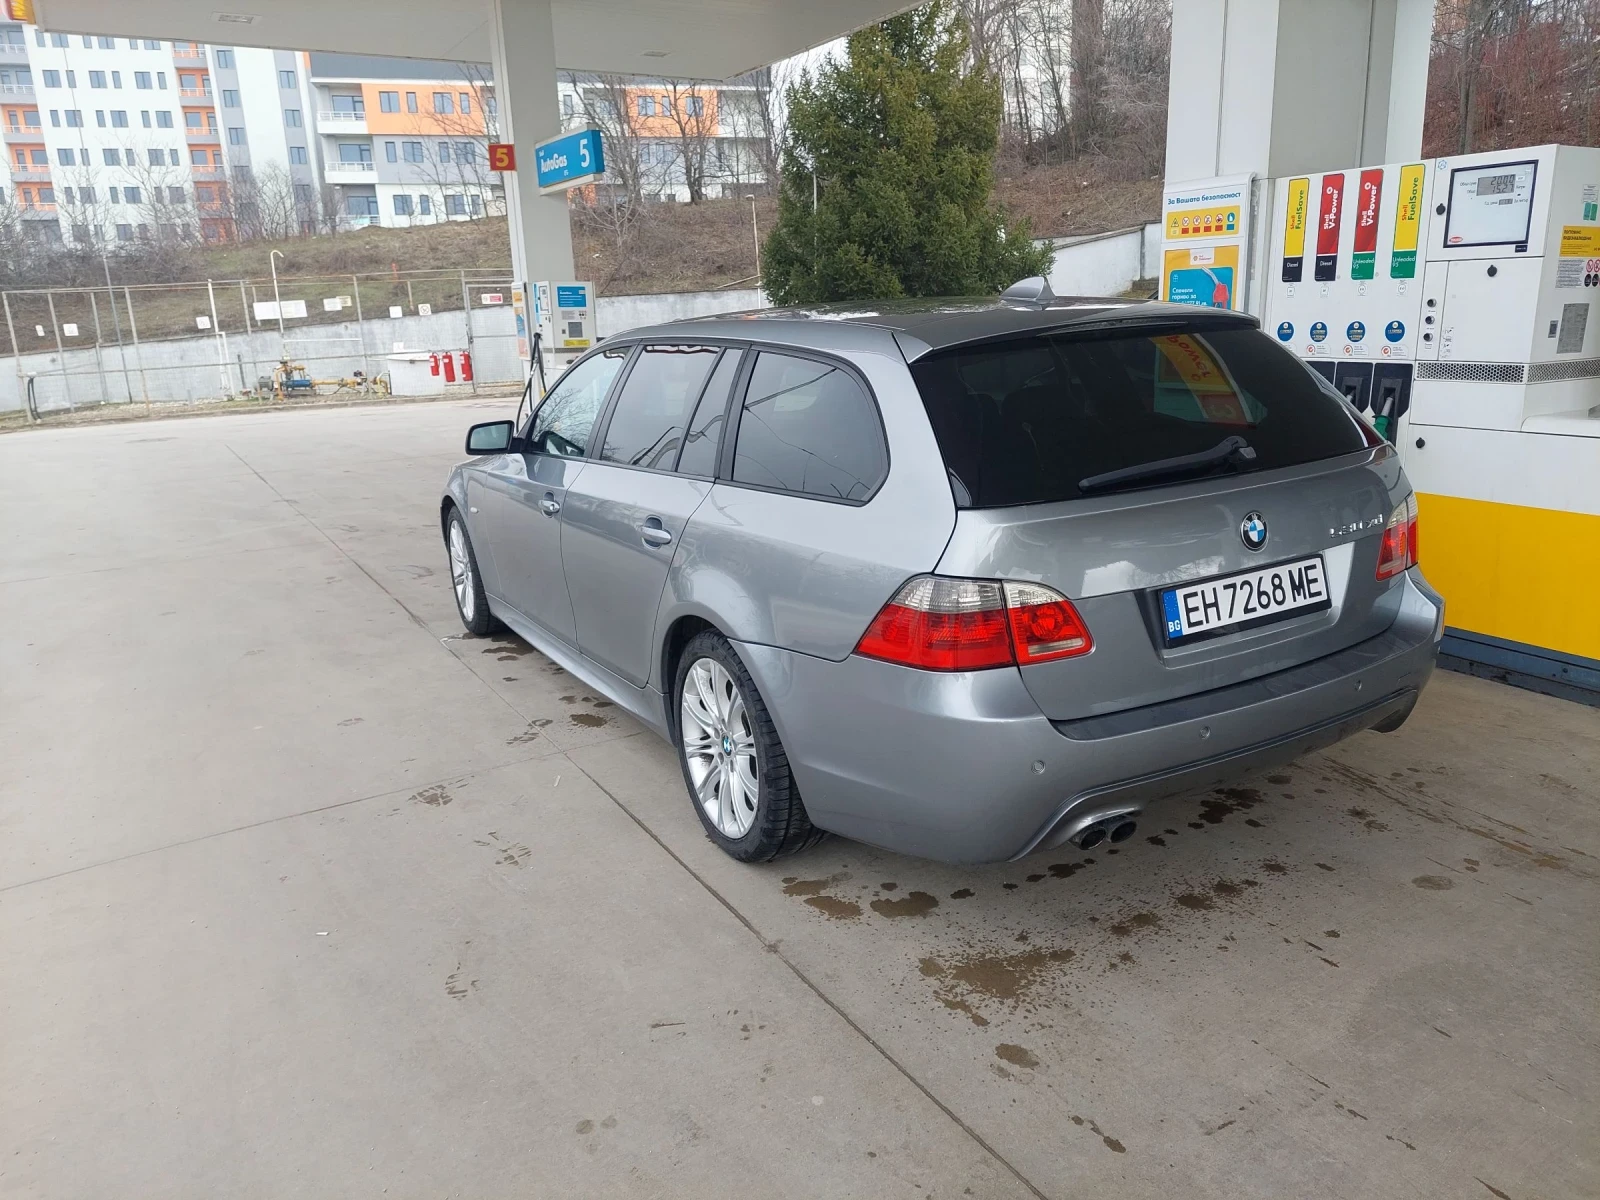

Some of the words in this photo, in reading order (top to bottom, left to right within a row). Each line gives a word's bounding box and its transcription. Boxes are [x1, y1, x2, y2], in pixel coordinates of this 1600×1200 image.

[495, 148, 509, 167] 5
[541, 153, 568, 173] AutoGas
[580, 139, 590, 168] 5
[1201, 192, 1241, 202] безопасност
[1295, 189, 1304, 229] FuelSave
[1328, 189, 1338, 229] V-Power
[1366, 184, 1377, 226] V-Power
[1408, 177, 1419, 221] FuelSave
[1167, 619, 1181, 632] BG
